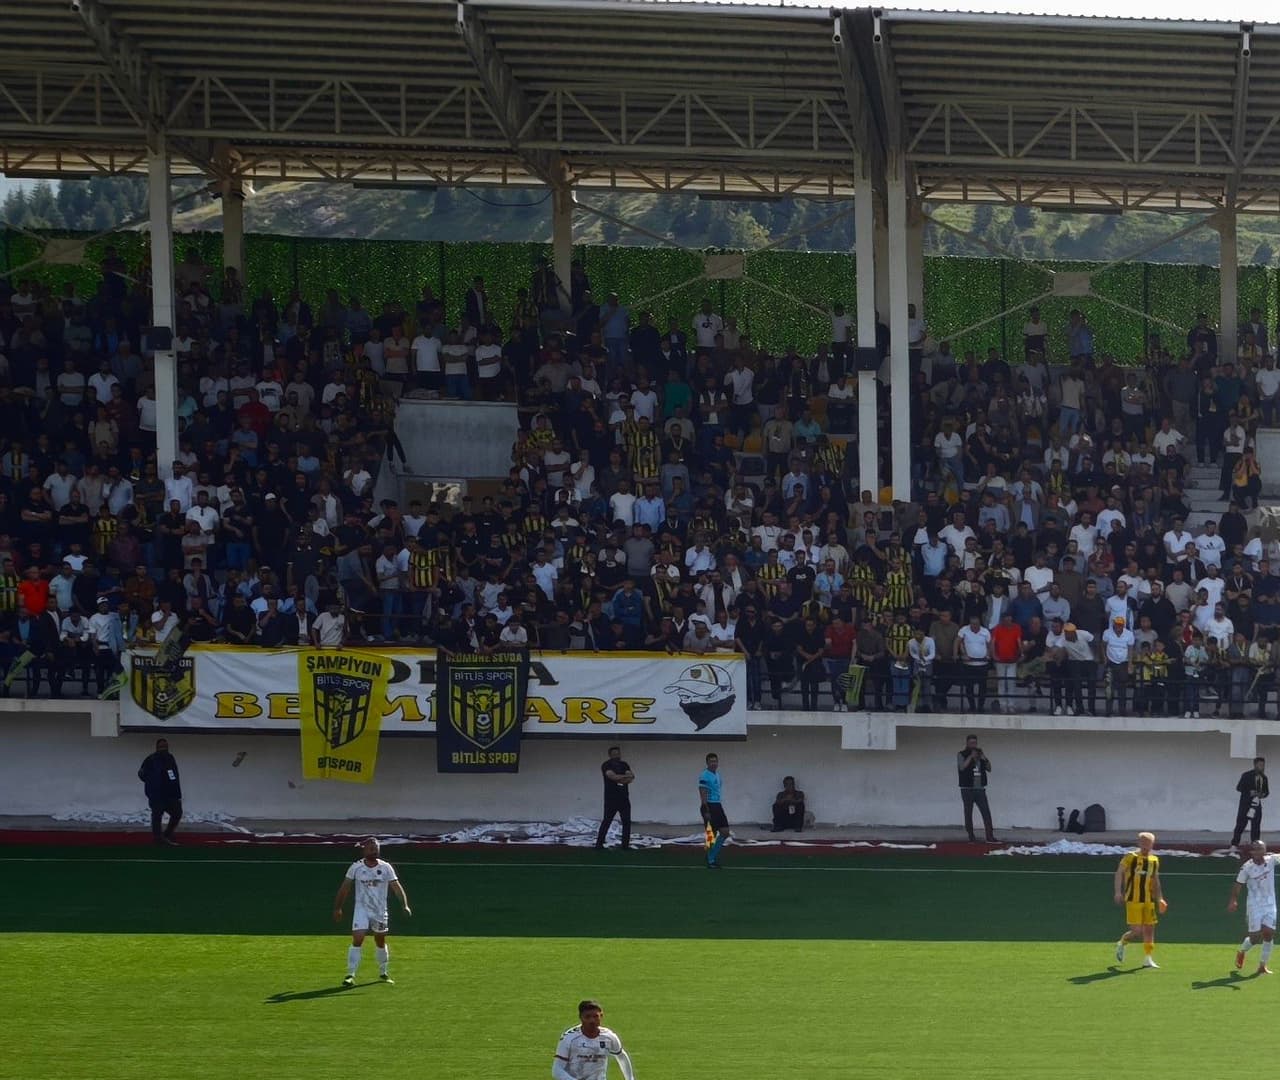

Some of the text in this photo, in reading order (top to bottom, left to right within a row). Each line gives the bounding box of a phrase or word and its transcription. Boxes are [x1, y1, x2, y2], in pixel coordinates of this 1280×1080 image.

[306, 655, 383, 676] ŞAMPİYON
[486, 671, 514, 681] SPOR
[342, 678, 371, 690] SPOR
[451, 751, 518, 764] BİTLİS SPOR
